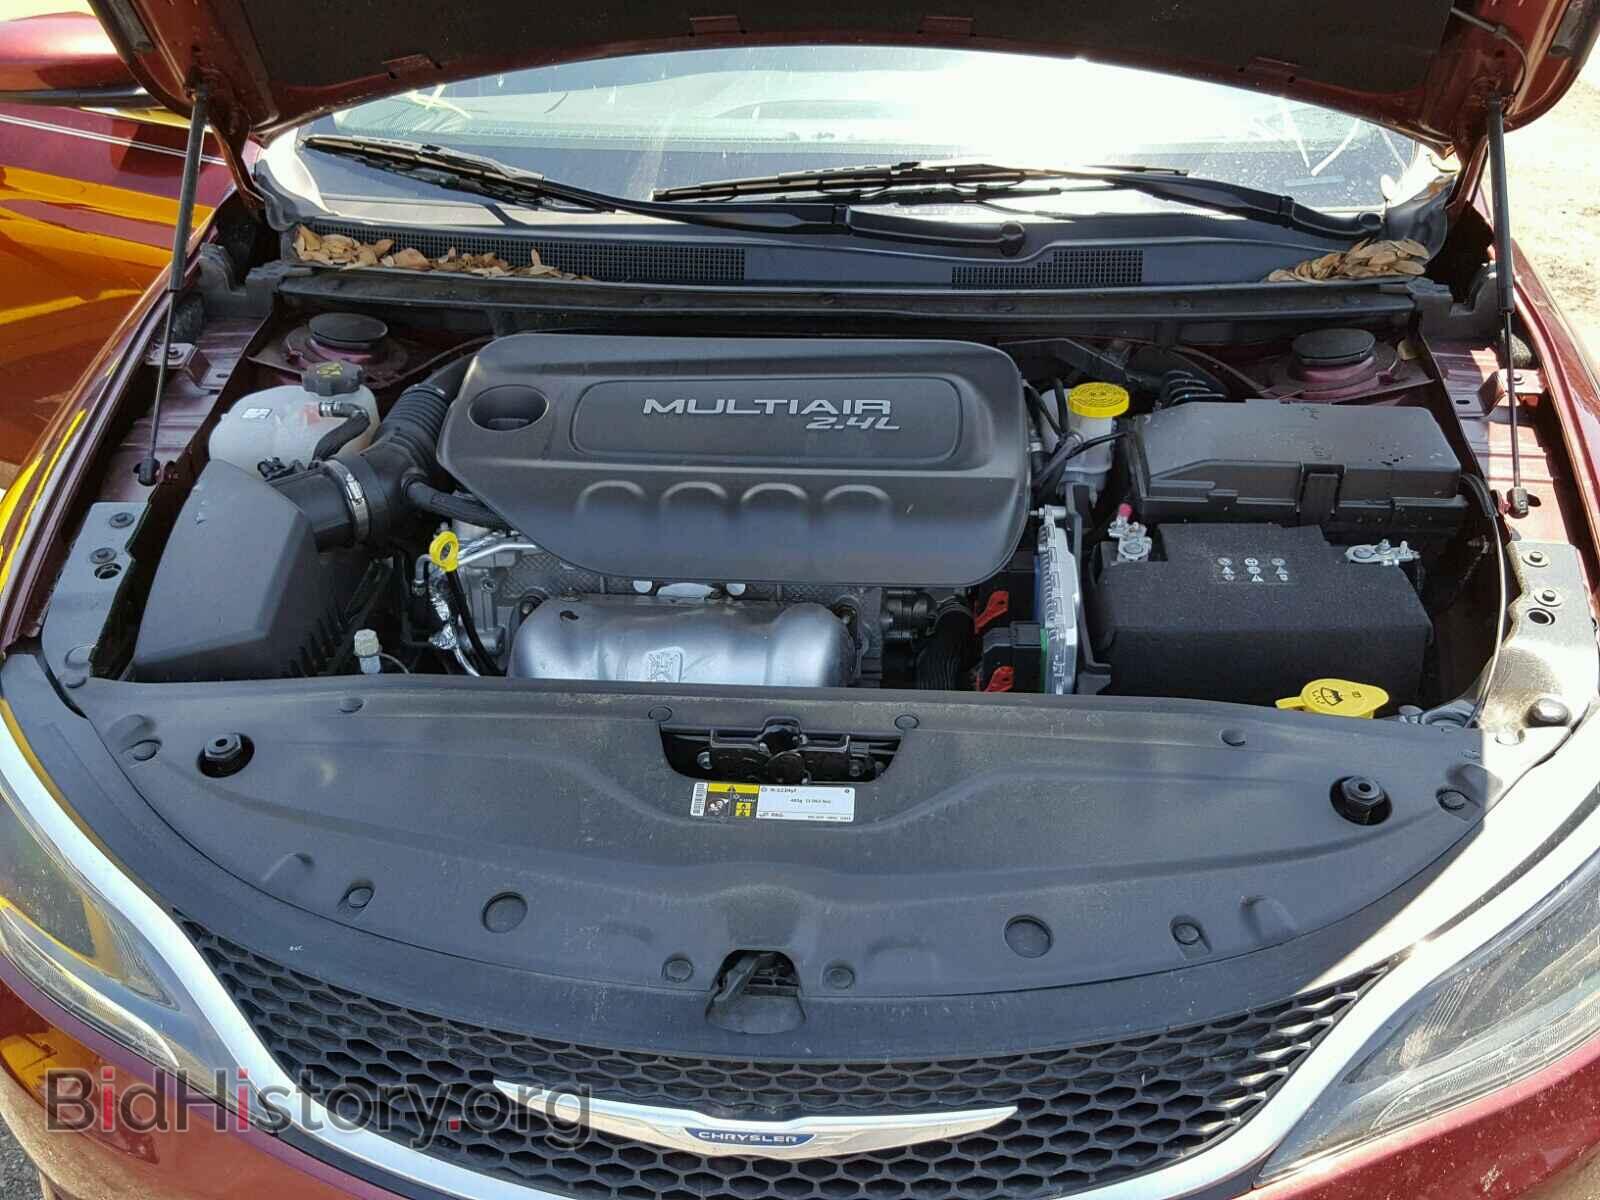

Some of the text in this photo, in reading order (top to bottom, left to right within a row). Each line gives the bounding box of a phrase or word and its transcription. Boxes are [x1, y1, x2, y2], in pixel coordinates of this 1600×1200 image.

[643, 399, 891, 414] MULTIAIR
[805, 416, 899, 430] 2.4L
[698, 1131, 797, 1143] CHRYSLER
